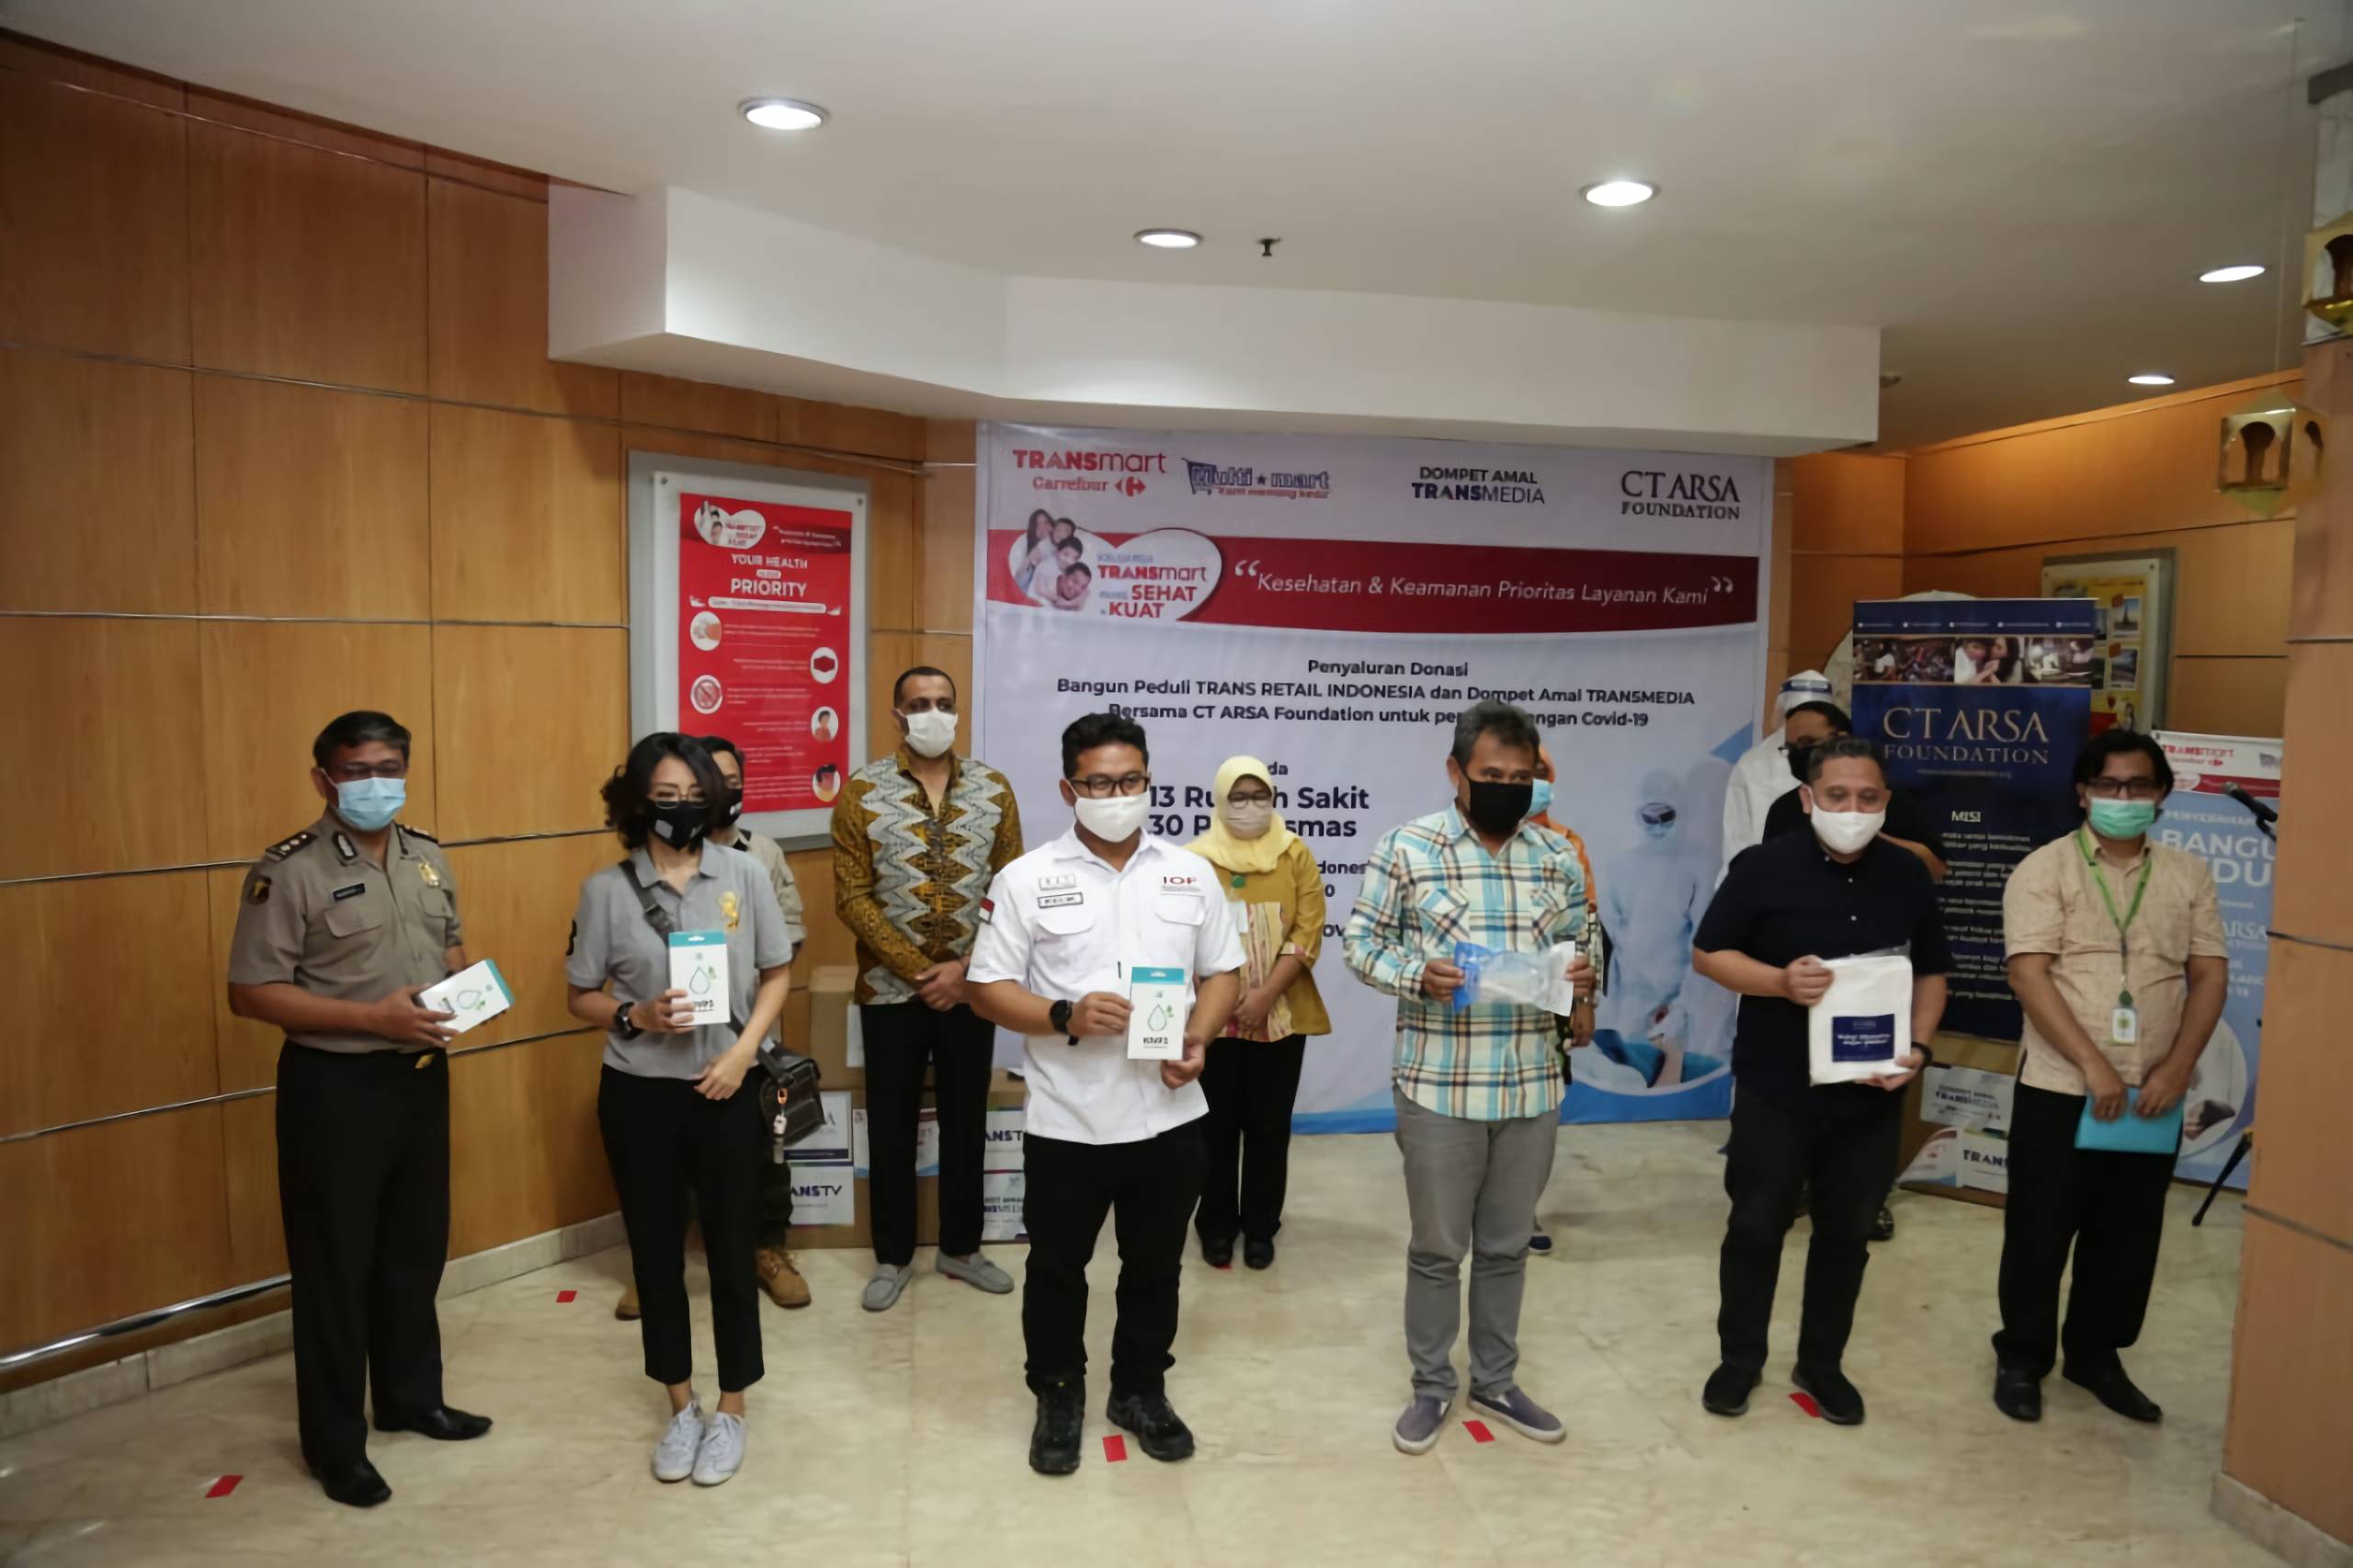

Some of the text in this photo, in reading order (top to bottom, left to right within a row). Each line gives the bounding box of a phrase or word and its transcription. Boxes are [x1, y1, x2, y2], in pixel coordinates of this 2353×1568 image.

[1013, 449, 1167, 474] TRANSmart
[1032, 477, 1108, 493] Carrefour
[1419, 467, 1538, 483] DOMPET AMAL
[1411, 483, 1545, 505] TRANSMEDIA
[1620, 471, 1741, 504] CT ARSA
[1620, 501, 1741, 520] FOUNDATION
[1097, 564, 1207, 583] TRANSmart
[731, 578, 808, 598] PRIORITY
[1131, 585, 1198, 602] SEHAT
[1368, 576, 1383, 595] &
[1390, 577, 1492, 598] Keamanan
[1498, 580, 1575, 601] Prioritas
[1581, 584, 1656, 607] Layanan
[1108, 603, 1165, 619] KUAT
[1308, 660, 1469, 678] Penyaluran Donasi
[1057, 679, 1696, 705] Bangun Peduli TRANS RETAIL INDONESIA dan Dompet Amal TRANSMEDIA
[1108, 704, 1188, 721] Bersama
[1192, 705, 1216, 720] CT
[1221, 706, 1270, 720] ARSA
[1274, 707, 1374, 722] Foundation
[1379, 709, 1430, 723] untuk
[1581, 711, 1650, 727] Covid-19
[1883, 707, 2050, 744] CT ARSA
[1884, 744, 2050, 766] FOUNDATION
[1297, 785, 1370, 810] Sakit
[1149, 814, 1184, 836] 30
